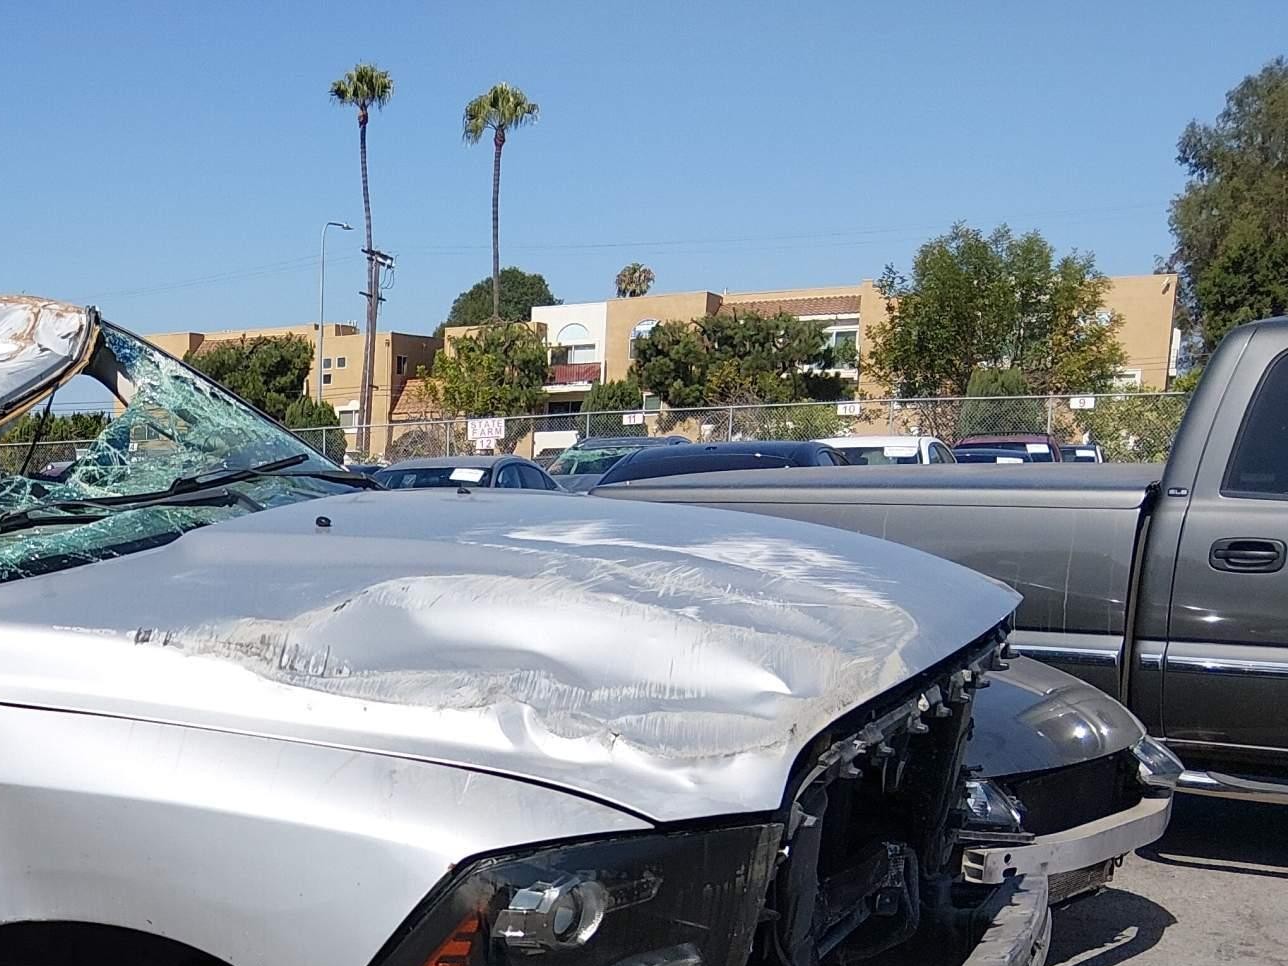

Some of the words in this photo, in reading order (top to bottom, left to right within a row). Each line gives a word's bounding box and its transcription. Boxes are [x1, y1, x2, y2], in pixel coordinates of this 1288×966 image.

[1078, 398, 1086, 408] 9
[843, 404, 856, 414] 10
[470, 419, 504, 429] STATE
[627, 414, 636, 424] 11
[471, 427, 502, 437] FARM
[479, 439, 492, 449] 12
